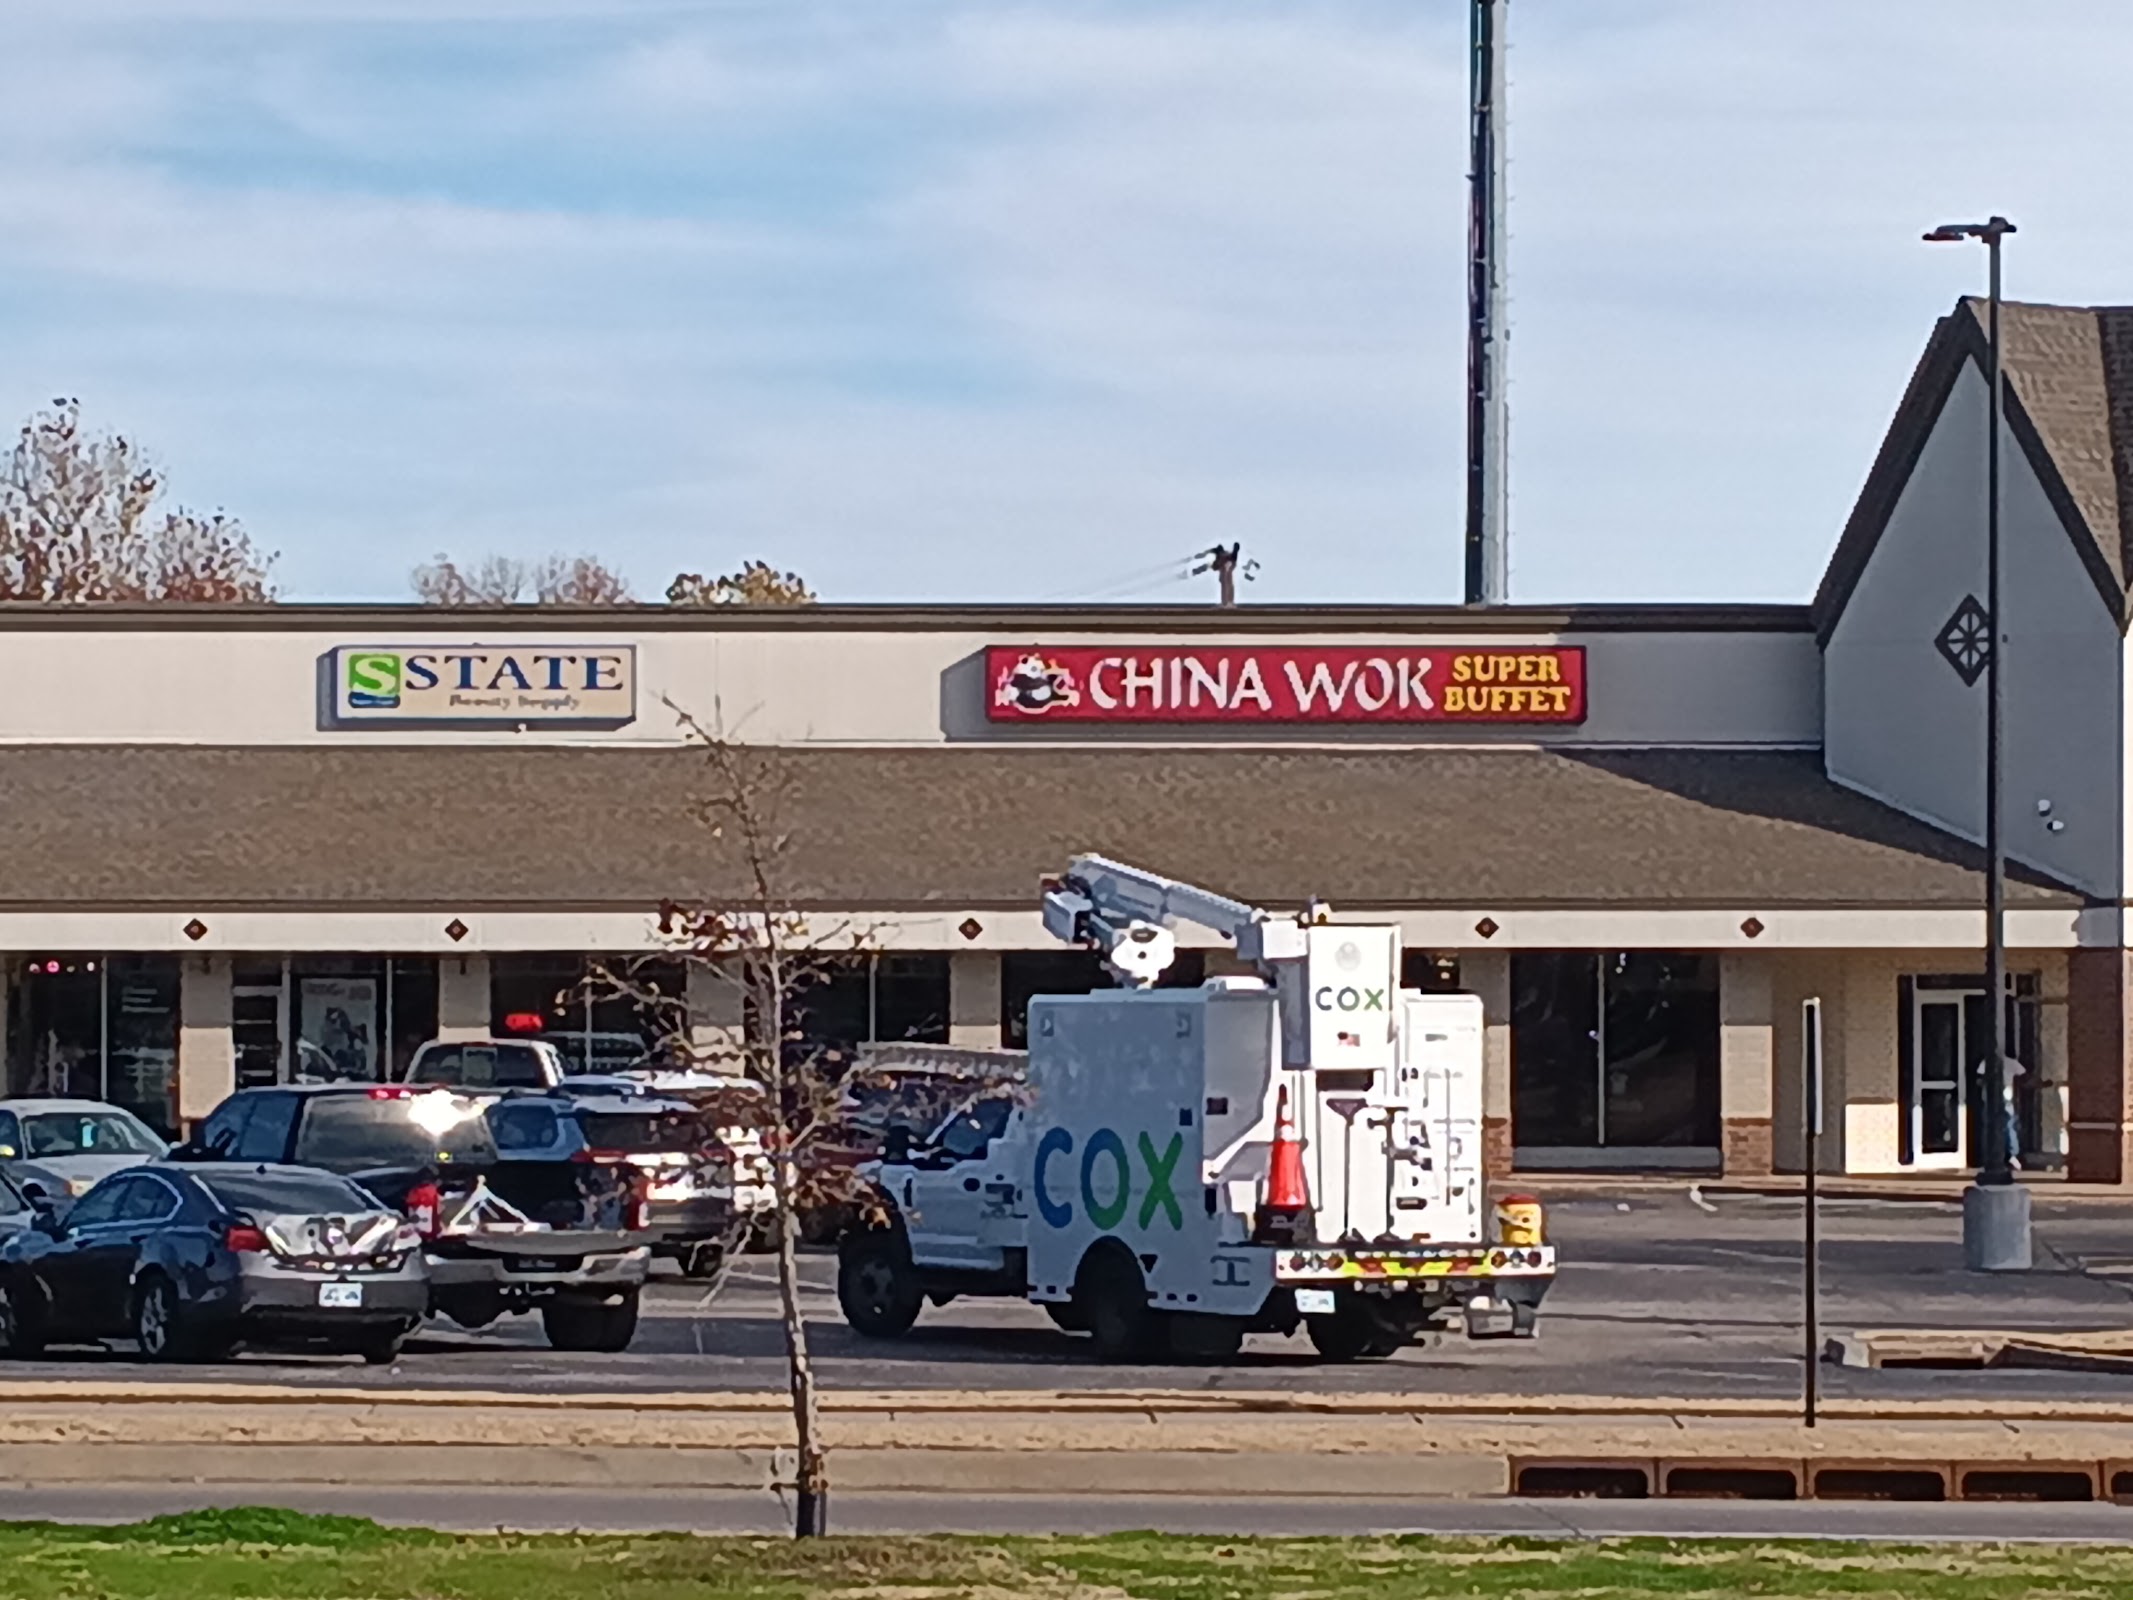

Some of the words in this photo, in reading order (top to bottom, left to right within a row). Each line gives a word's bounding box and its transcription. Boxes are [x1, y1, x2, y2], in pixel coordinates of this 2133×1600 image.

[405, 655, 624, 691] STATE
[1452, 655, 1560, 682] SUPER
[1089, 657, 1272, 711] CHINA
[1283, 657, 1434, 712] WOK
[1444, 686, 1571, 711] BUFFET
[1315, 986, 1385, 1011] COX
[1034, 1126, 1183, 1231] COX
